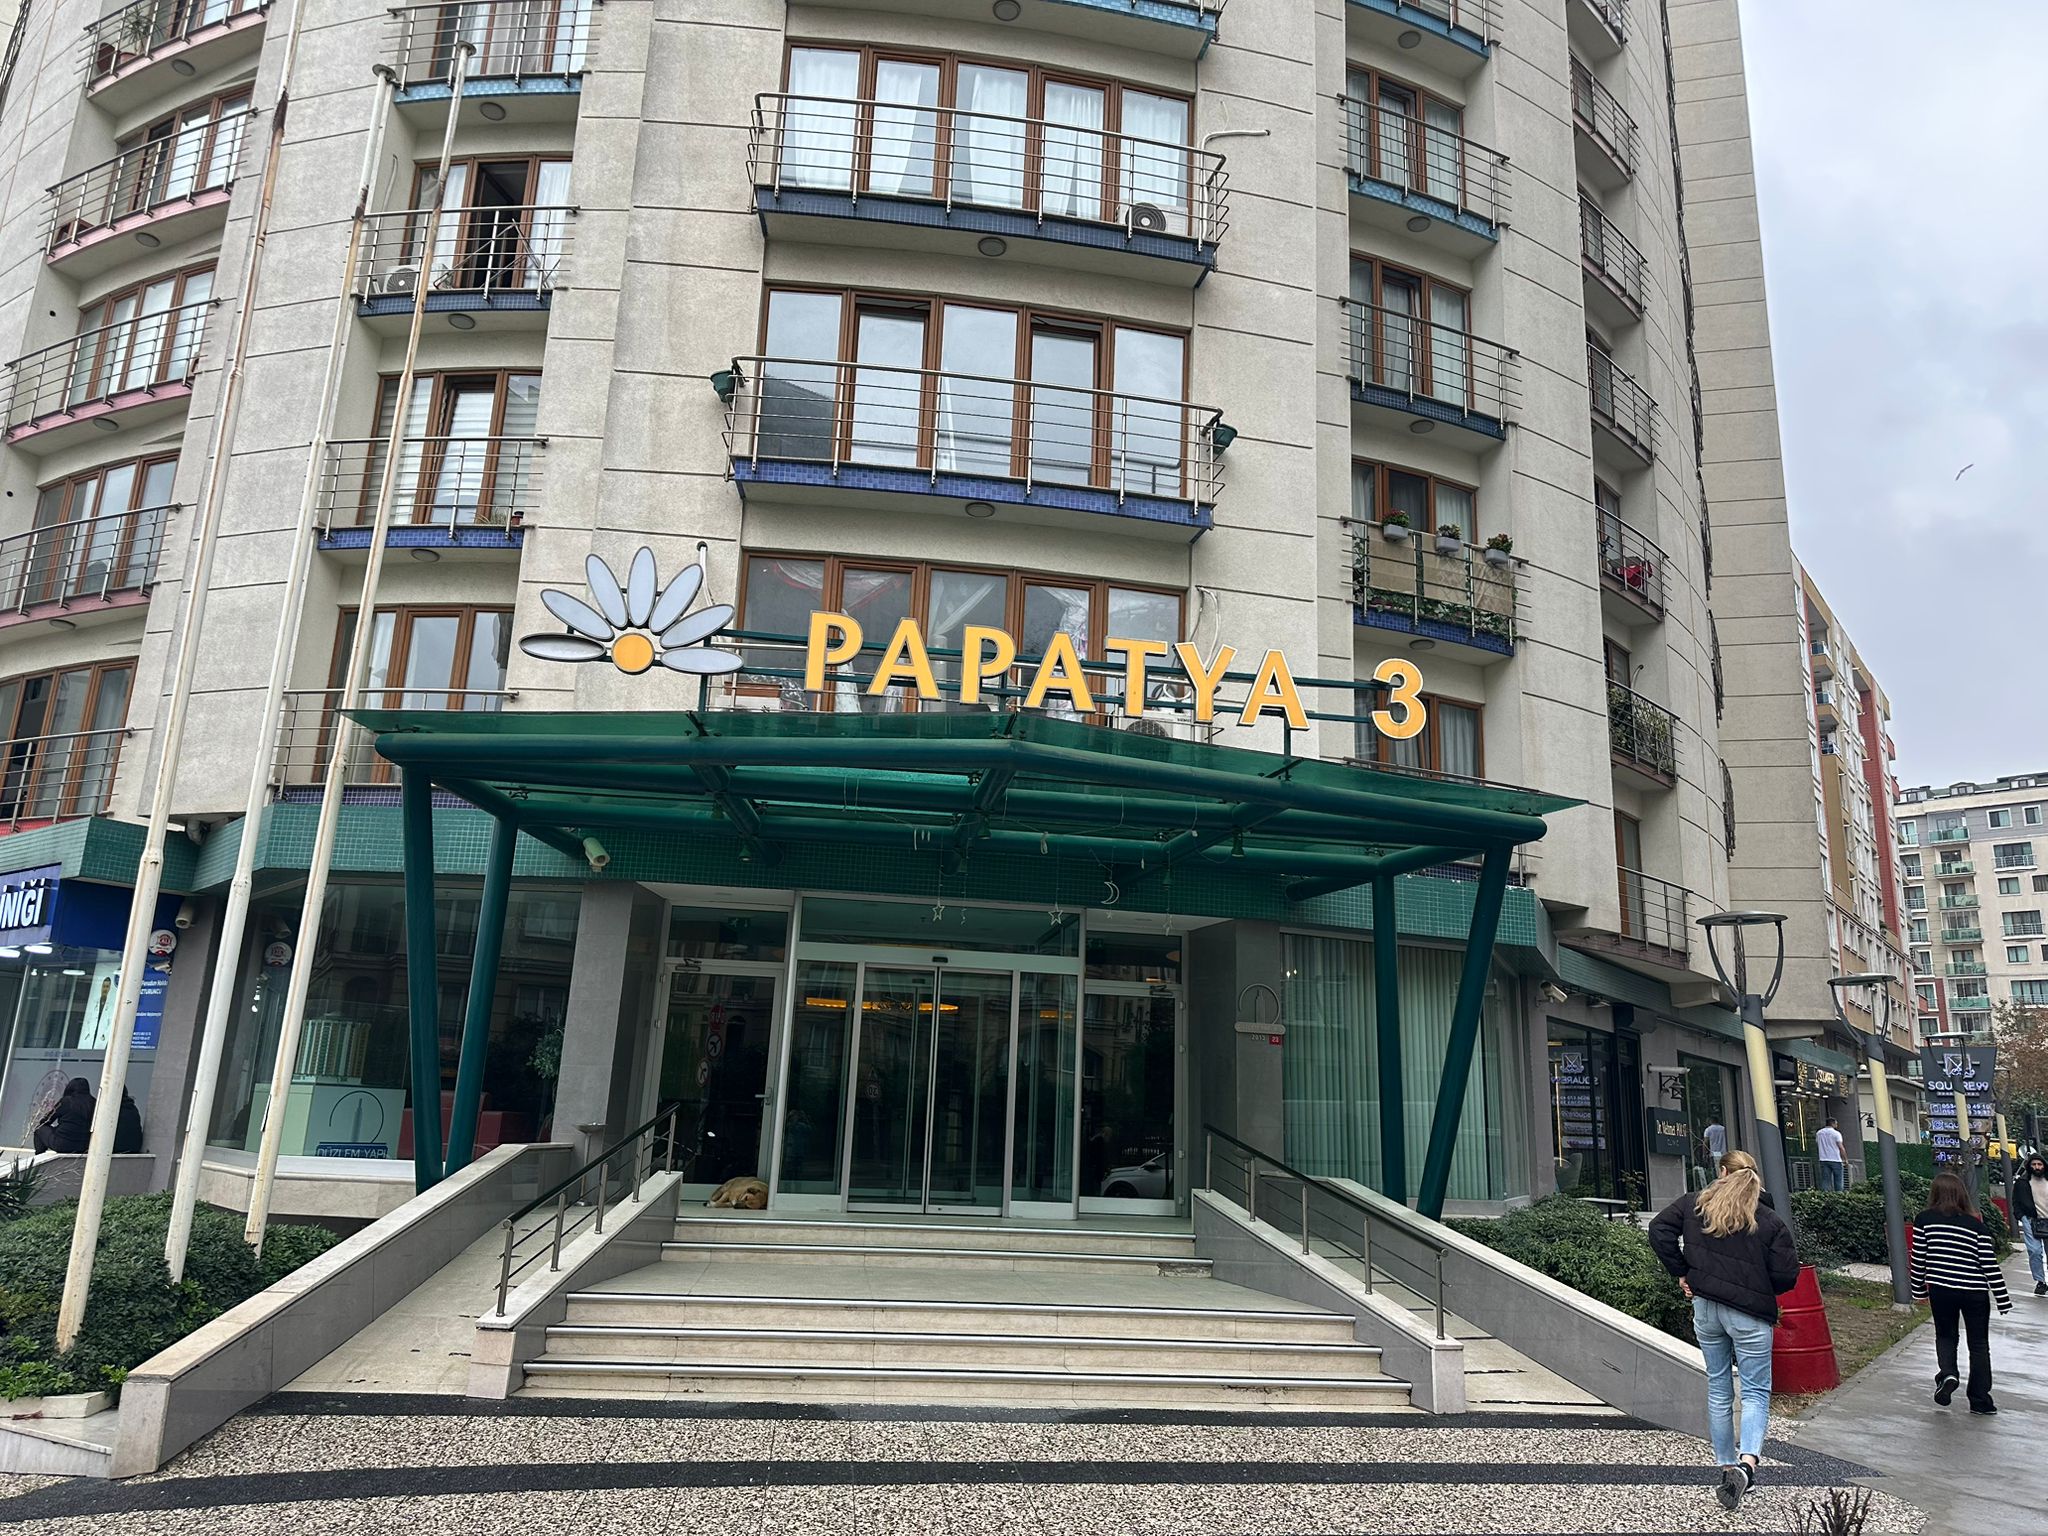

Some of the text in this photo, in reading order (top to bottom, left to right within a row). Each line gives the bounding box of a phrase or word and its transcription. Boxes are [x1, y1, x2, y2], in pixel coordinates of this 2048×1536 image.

[804, 609, 1428, 740] PAPATYA 3
[1928, 1081, 1989, 1091] SQURE99
